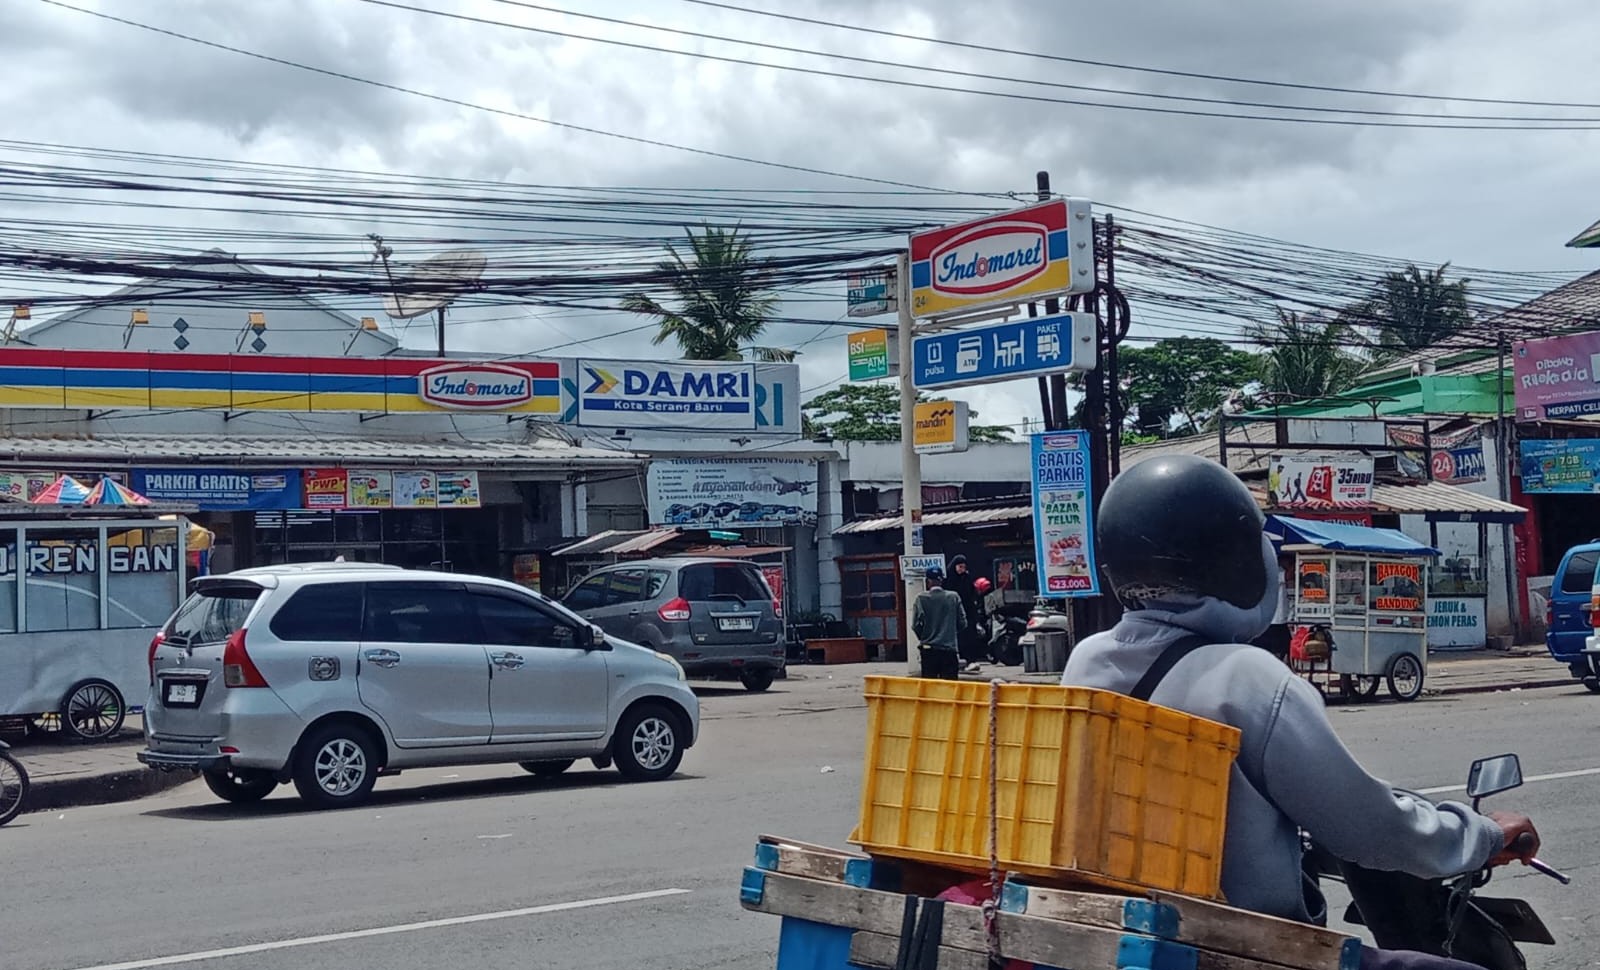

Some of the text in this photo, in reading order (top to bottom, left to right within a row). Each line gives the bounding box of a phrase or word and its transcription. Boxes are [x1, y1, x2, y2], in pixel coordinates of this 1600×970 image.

[938, 237, 1042, 283] Indomaret
[1037, 323, 1062, 333] PAKET
[867, 355, 885, 368] ATM
[963, 358, 977, 367] ATM
[924, 364, 945, 378] pulsa
[430, 376, 525, 395] Indomaret
[623, 370, 749, 398] DAMRI
[614, 401, 723, 414] Kota Serang Baru
[1547, 405, 1582, 417] MERPATI
[1039, 452, 1084, 467] GRATIS
[1433, 453, 1483, 474] 24 JAM
[1039, 467, 1085, 482] PARKIR
[145, 475, 197, 490] PARKIR
[200, 475, 249, 490] GRATIS
[312, 479, 338, 490] PWP
[1046, 502, 1080, 514] BAZAR
[1048, 514, 1081, 525] TELUR
[1377, 564, 1419, 584] BATAGOR
[1377, 597, 1418, 610] BANDUNG
[1434, 601, 1467, 613] JERUK &
[1427, 615, 1478, 627] EMON PERAS
